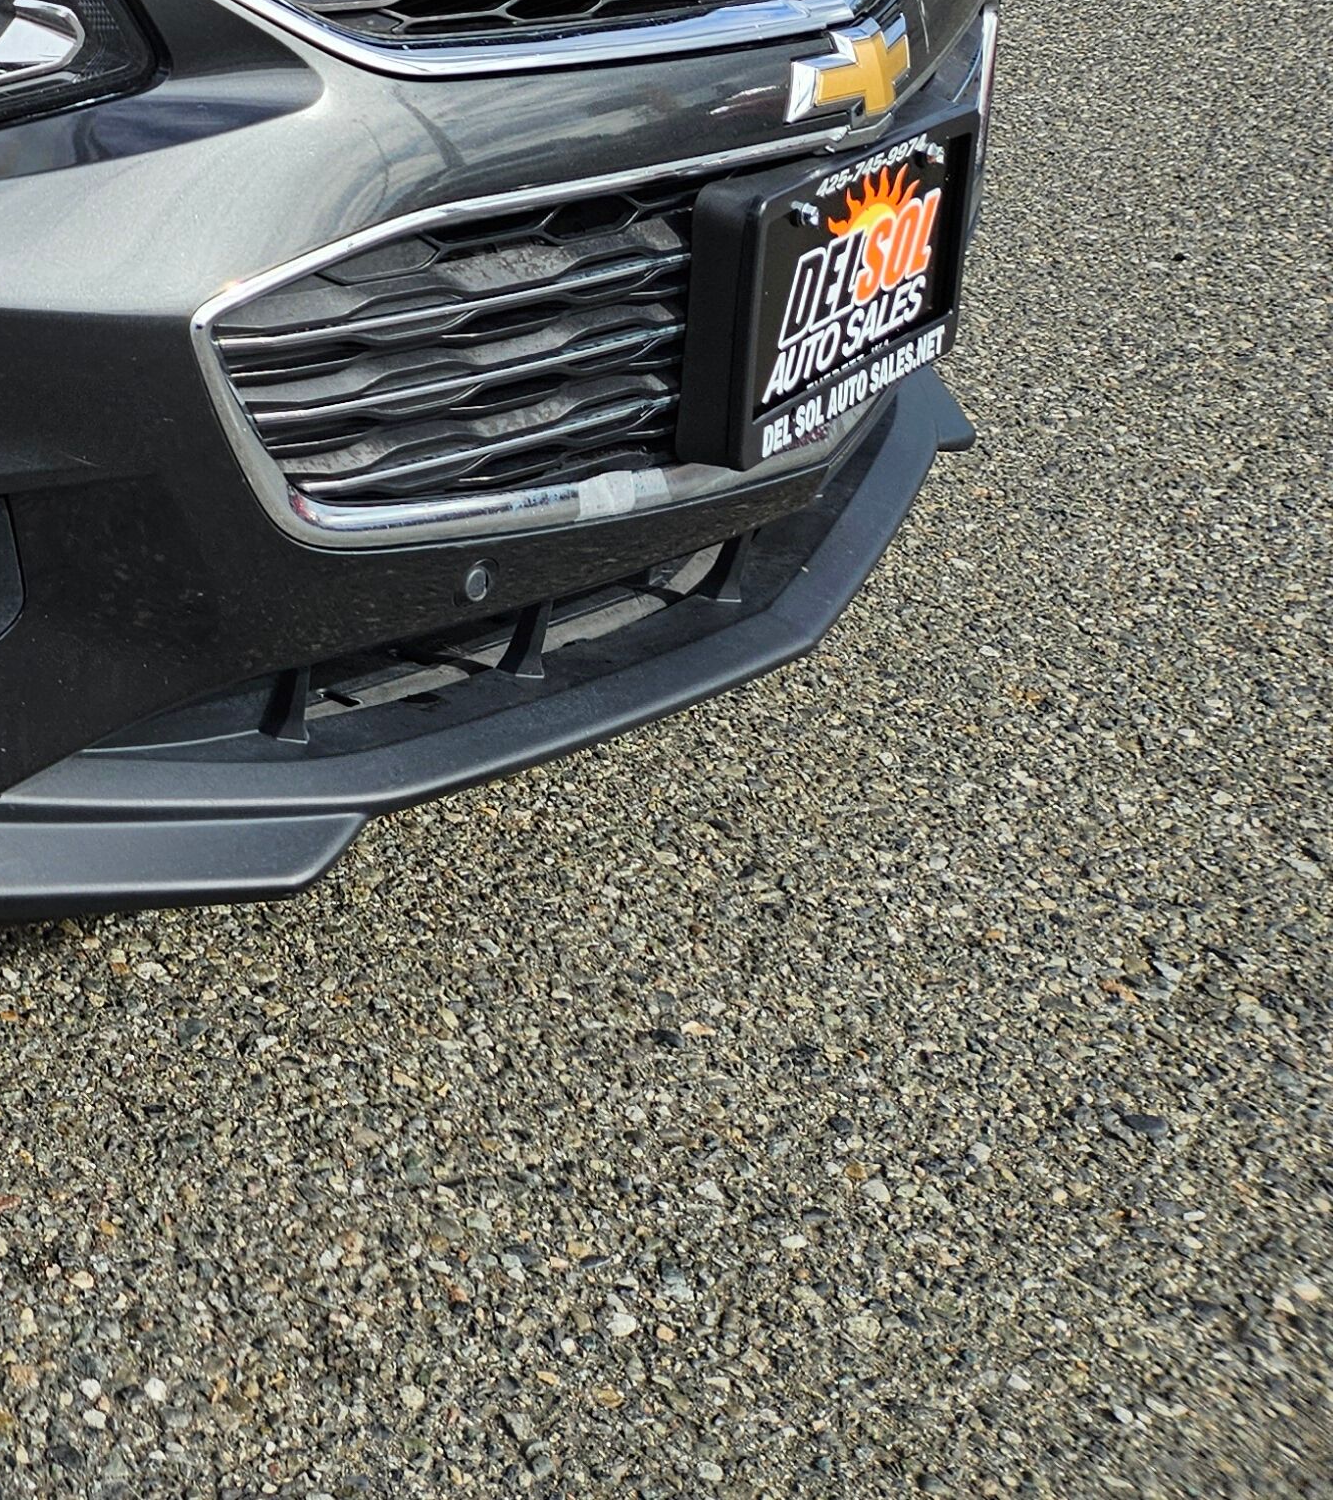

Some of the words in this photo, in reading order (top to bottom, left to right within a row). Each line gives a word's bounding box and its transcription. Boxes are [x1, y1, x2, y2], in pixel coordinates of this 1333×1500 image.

[816, 133, 928, 198] 425-745-9974
[761, 320, 841, 404] AUTO
[842, 275, 926, 358] SALES
[761, 414, 792, 458] DEL
[795, 395, 825, 438] SOL
[826, 369, 869, 420] AUTO
[869, 324, 945, 394] SALES.NET
